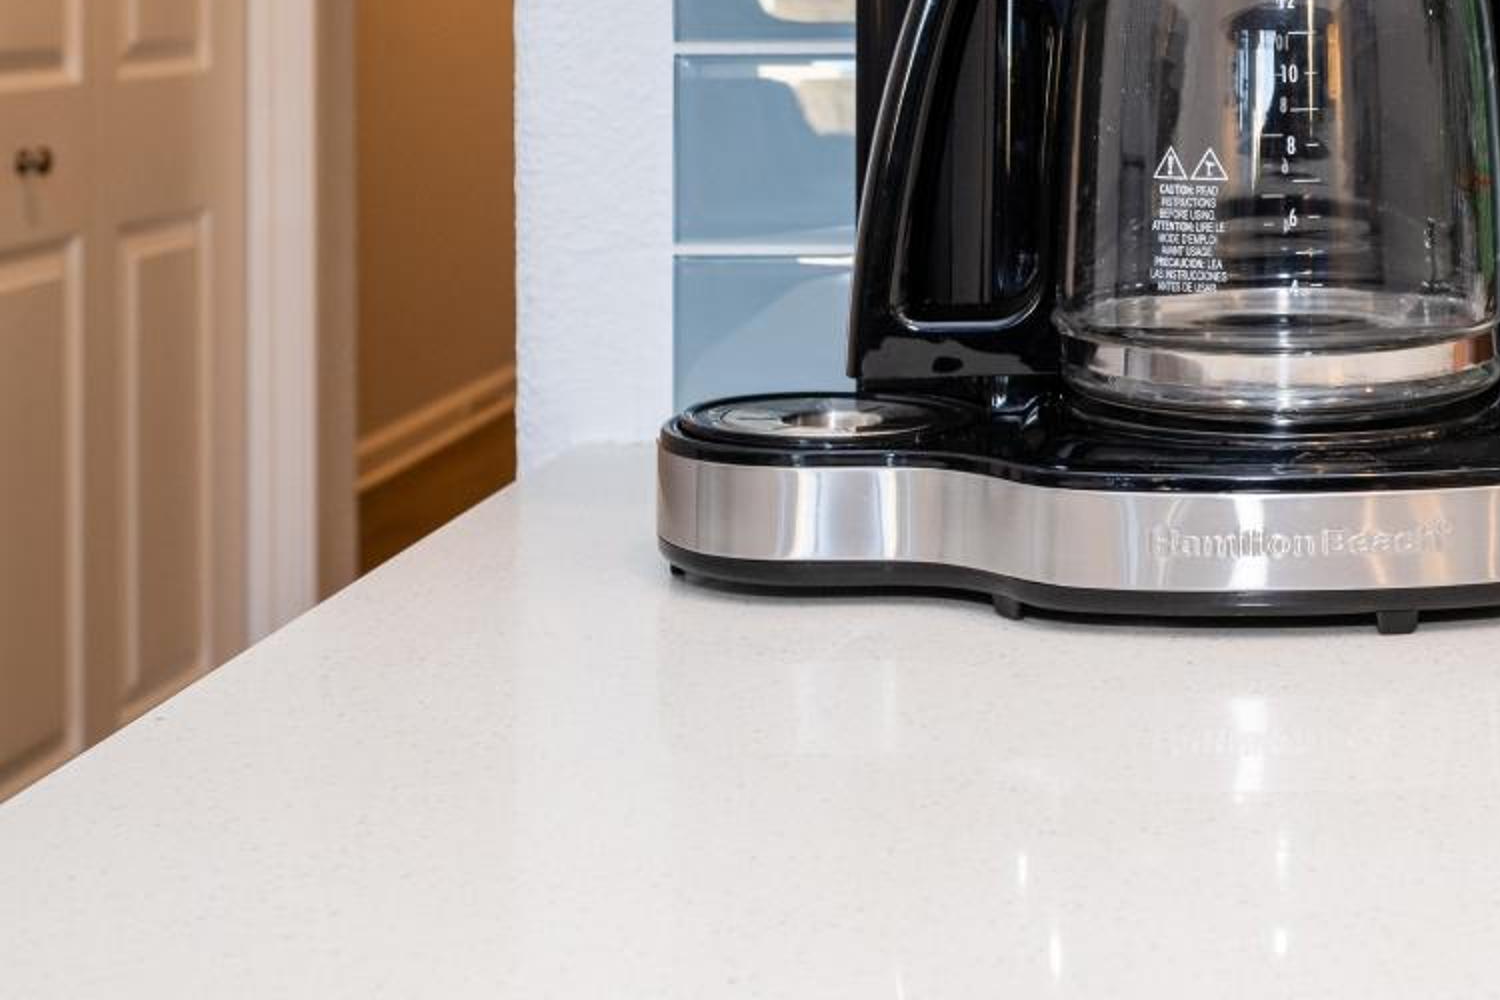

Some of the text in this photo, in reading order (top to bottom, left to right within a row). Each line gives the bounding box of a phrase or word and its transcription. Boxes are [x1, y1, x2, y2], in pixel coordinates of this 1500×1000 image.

[1280, 63, 1299, 84] 10
[1286, 136, 1296, 155] 8
[1289, 207, 1297, 227] 6
